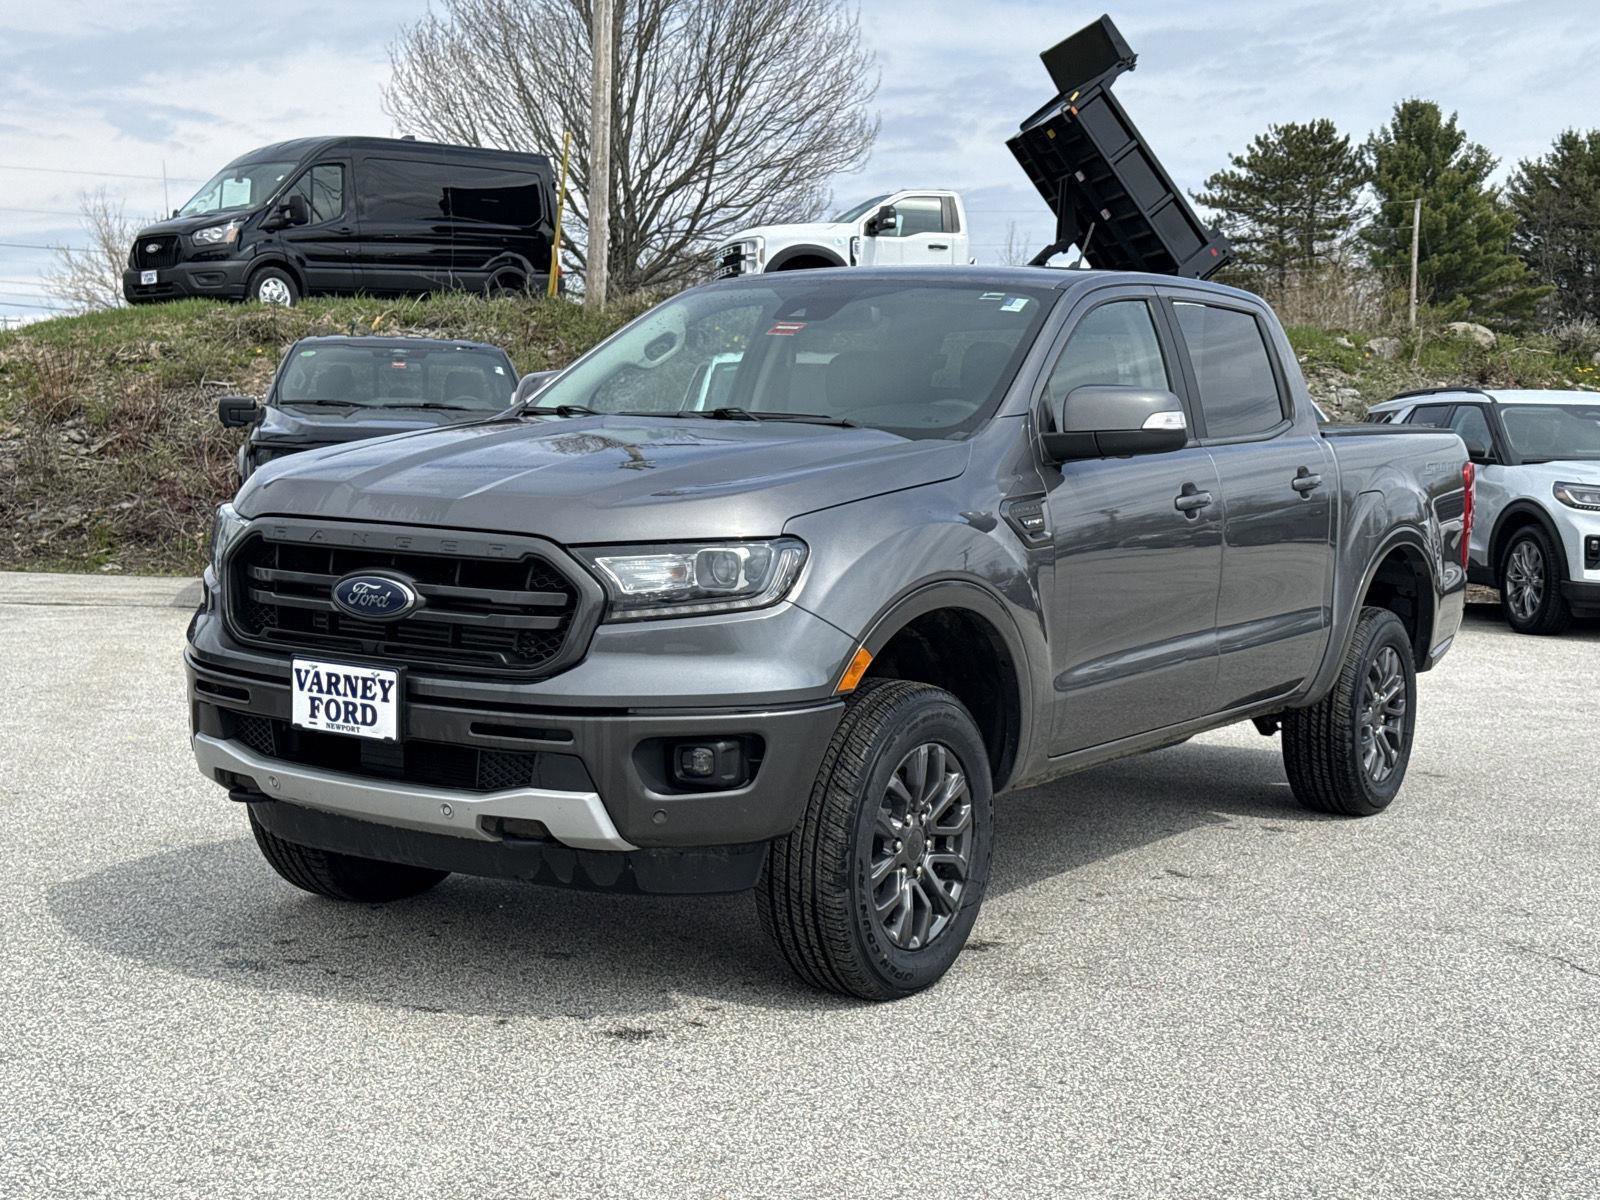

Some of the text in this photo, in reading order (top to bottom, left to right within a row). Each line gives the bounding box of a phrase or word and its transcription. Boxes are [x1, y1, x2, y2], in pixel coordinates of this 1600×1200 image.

[347, 581, 392, 608] Ford
[294, 667, 395, 703] VARNEY
[308, 695, 378, 727] FORD
[325, 722, 361, 733] NEWPORT
